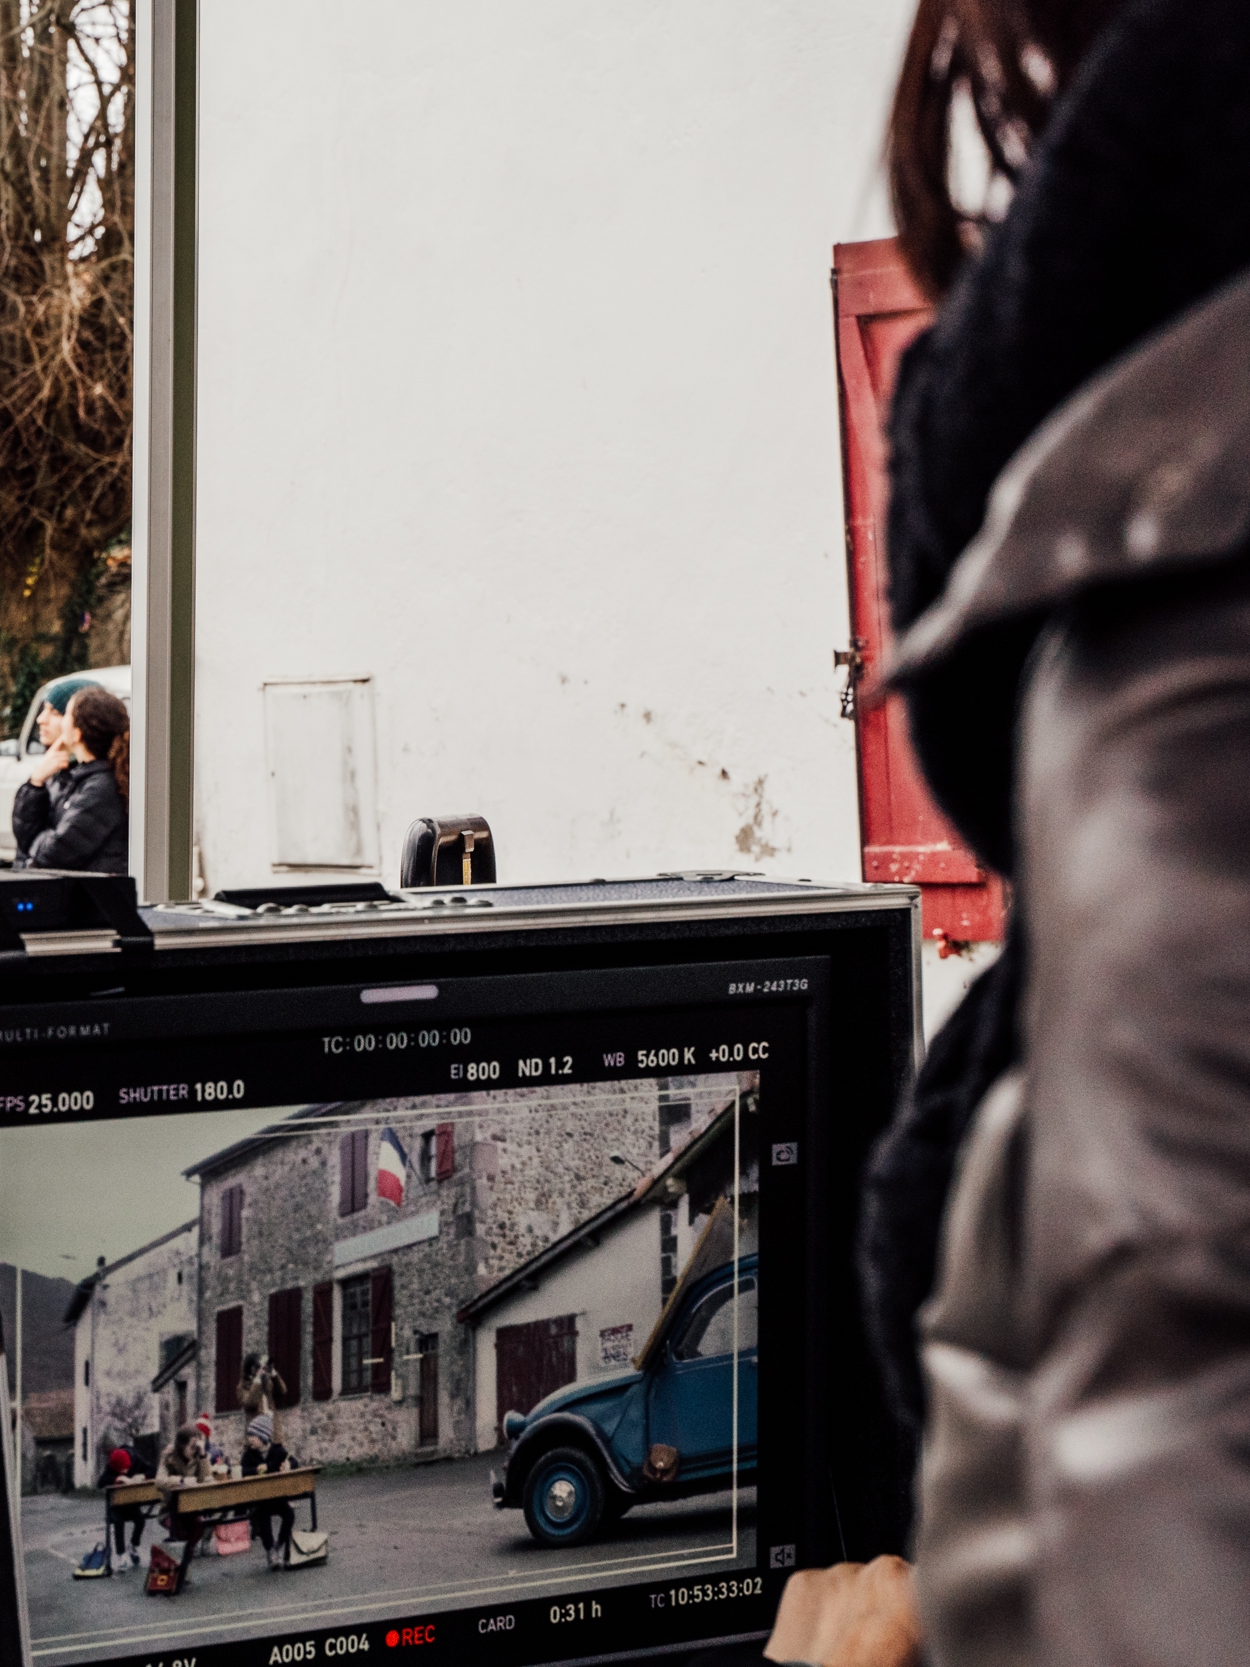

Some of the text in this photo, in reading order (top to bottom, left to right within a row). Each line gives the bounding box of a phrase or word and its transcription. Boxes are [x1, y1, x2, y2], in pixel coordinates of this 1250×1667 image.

[729, 979, 808, 994] BXM-243T3G
[603, 1047, 695, 1068] WB 5600 K
[710, 1042, 768, 1061] +0.0 CC
[467, 1061, 499, 1080] 800
[518, 1056, 572, 1077] ND 1.2
[119, 1080, 244, 1103] SHUTTER 180.0
[29, 1091, 94, 1114] 25.000
[649, 1577, 763, 1608] TC 10:53:33:02
[550, 1601, 601, 1623] 0:31 h
[479, 1615, 515, 1633] CARD
[402, 1625, 434, 1646] REC
[269, 1634, 369, 1665] A005 C004
